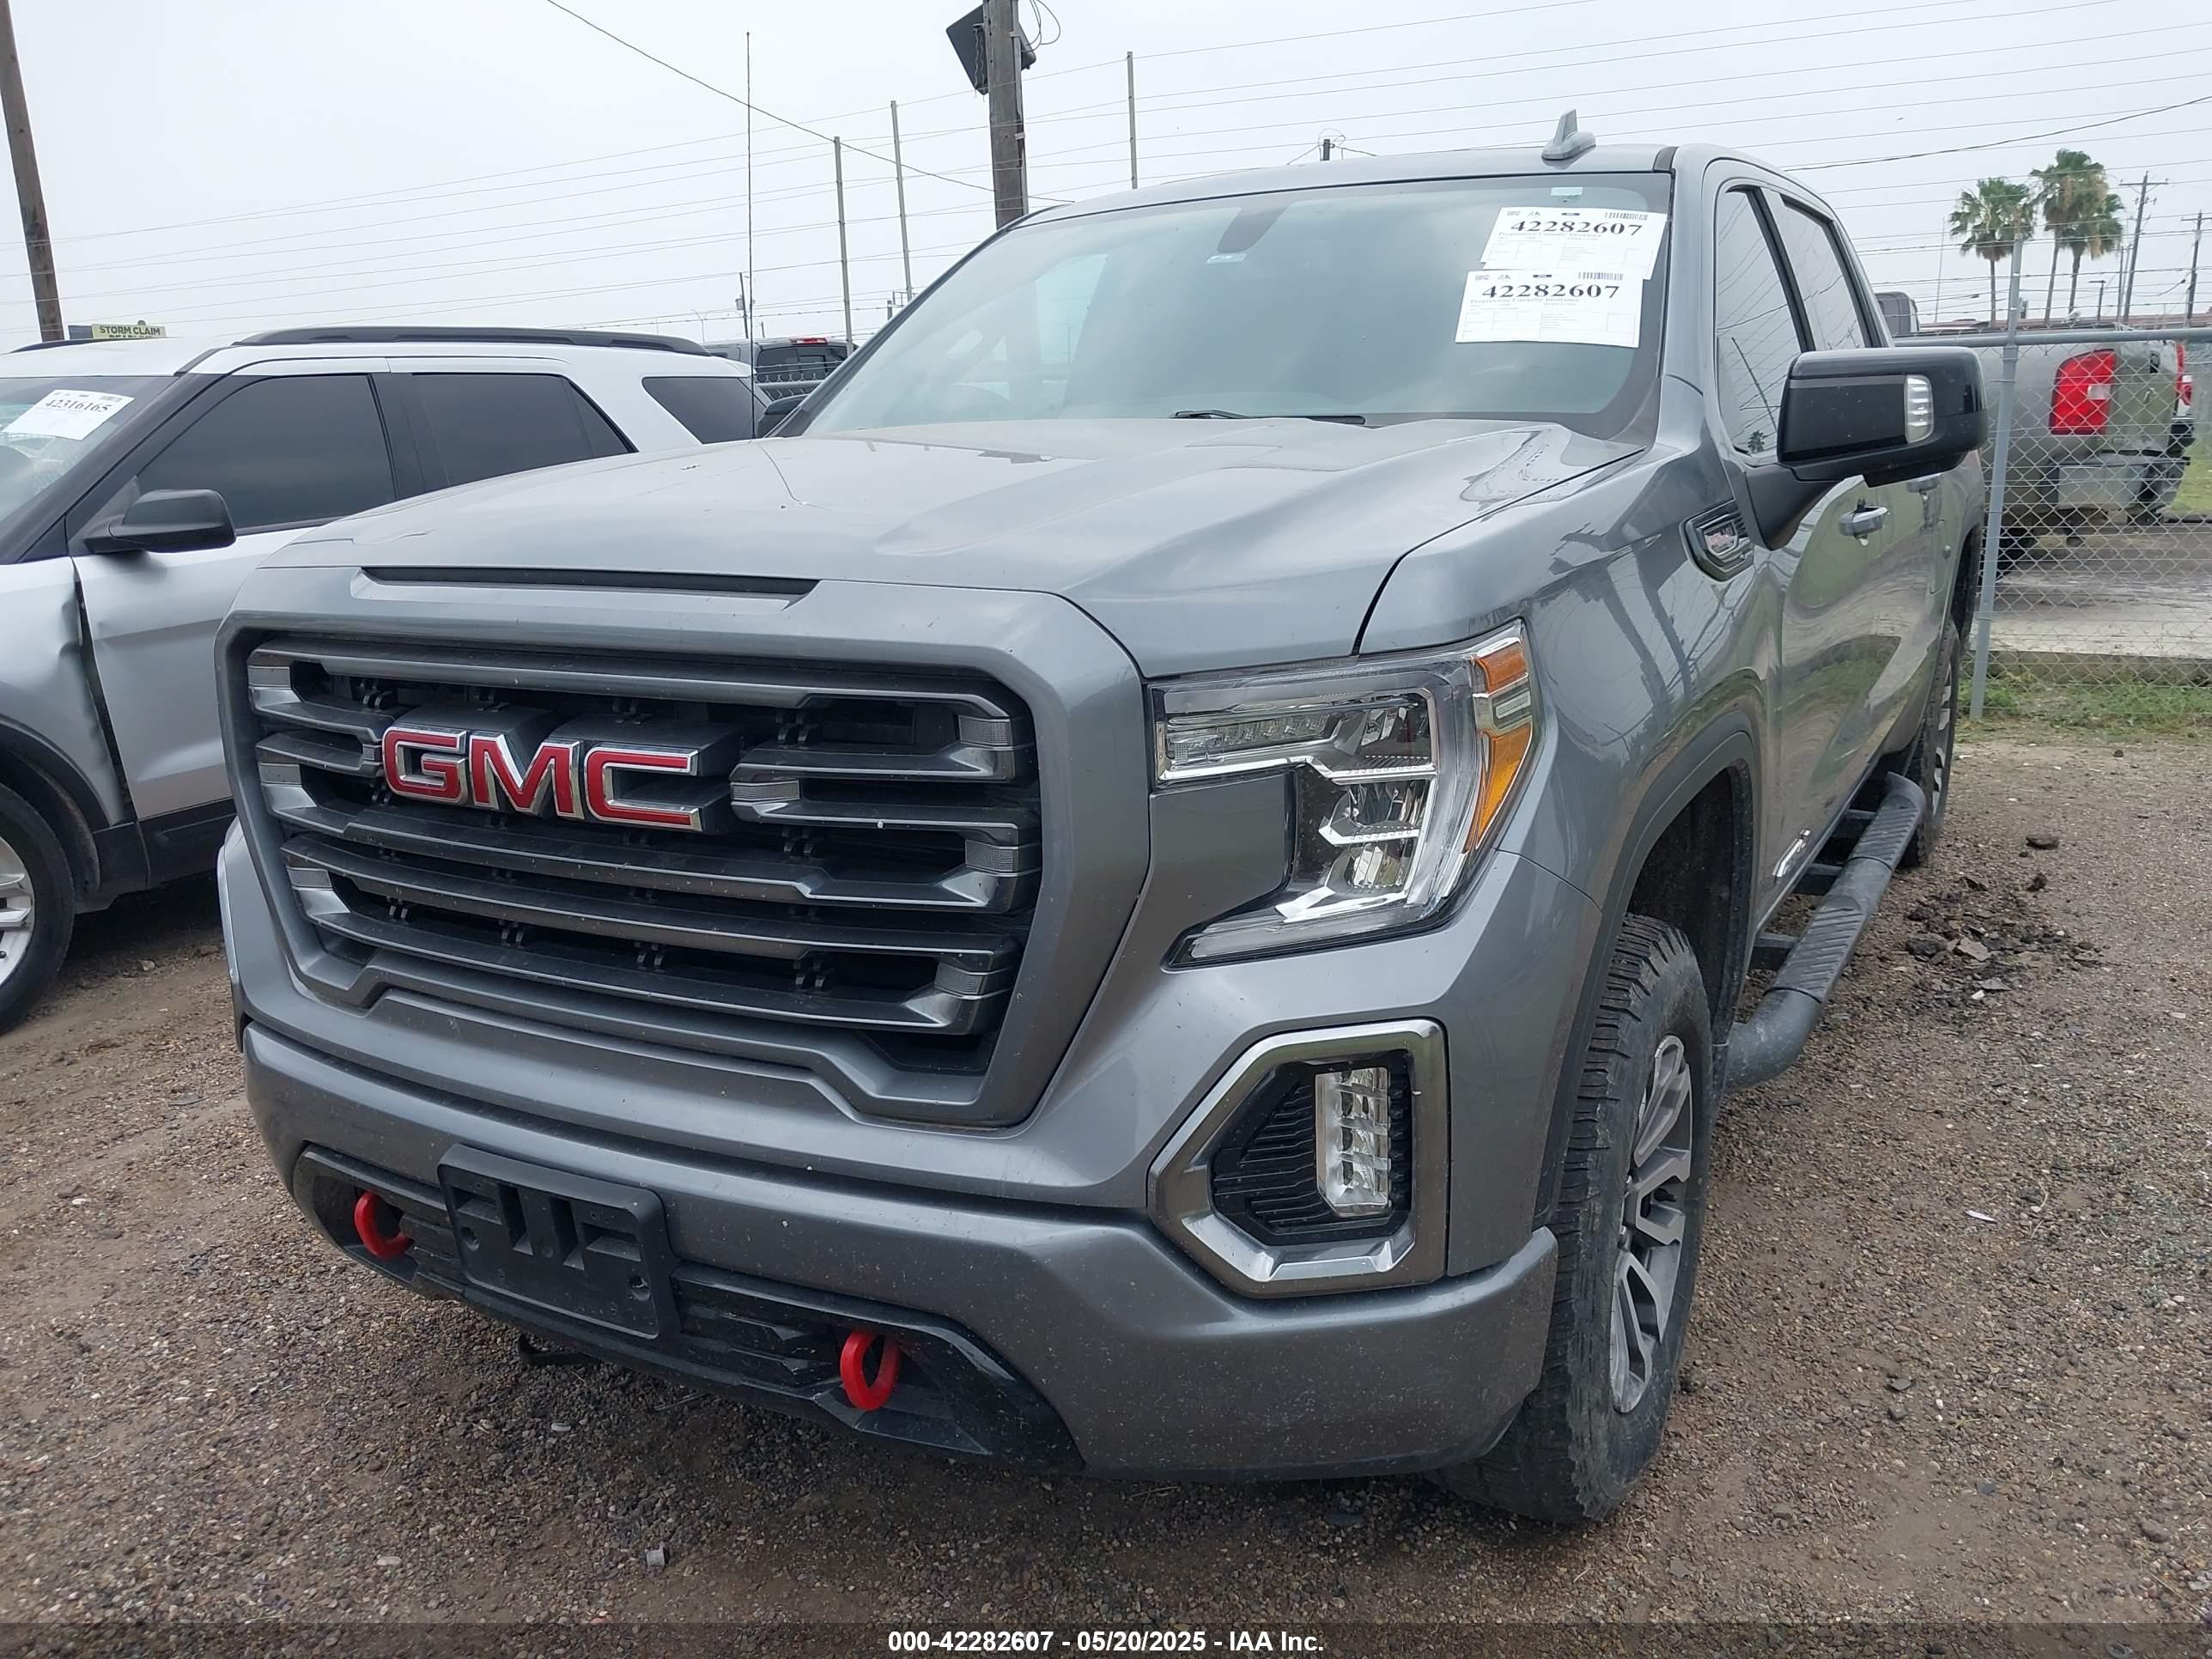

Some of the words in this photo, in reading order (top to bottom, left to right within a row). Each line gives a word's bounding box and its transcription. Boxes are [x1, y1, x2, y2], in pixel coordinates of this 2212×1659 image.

[1510, 220, 1644, 236] 42282607
[1481, 284, 1620, 299] 42282607
[99, 325, 131, 335] STORM
[132, 326, 161, 336] CLAIM
[381, 726, 704, 832] GMC
